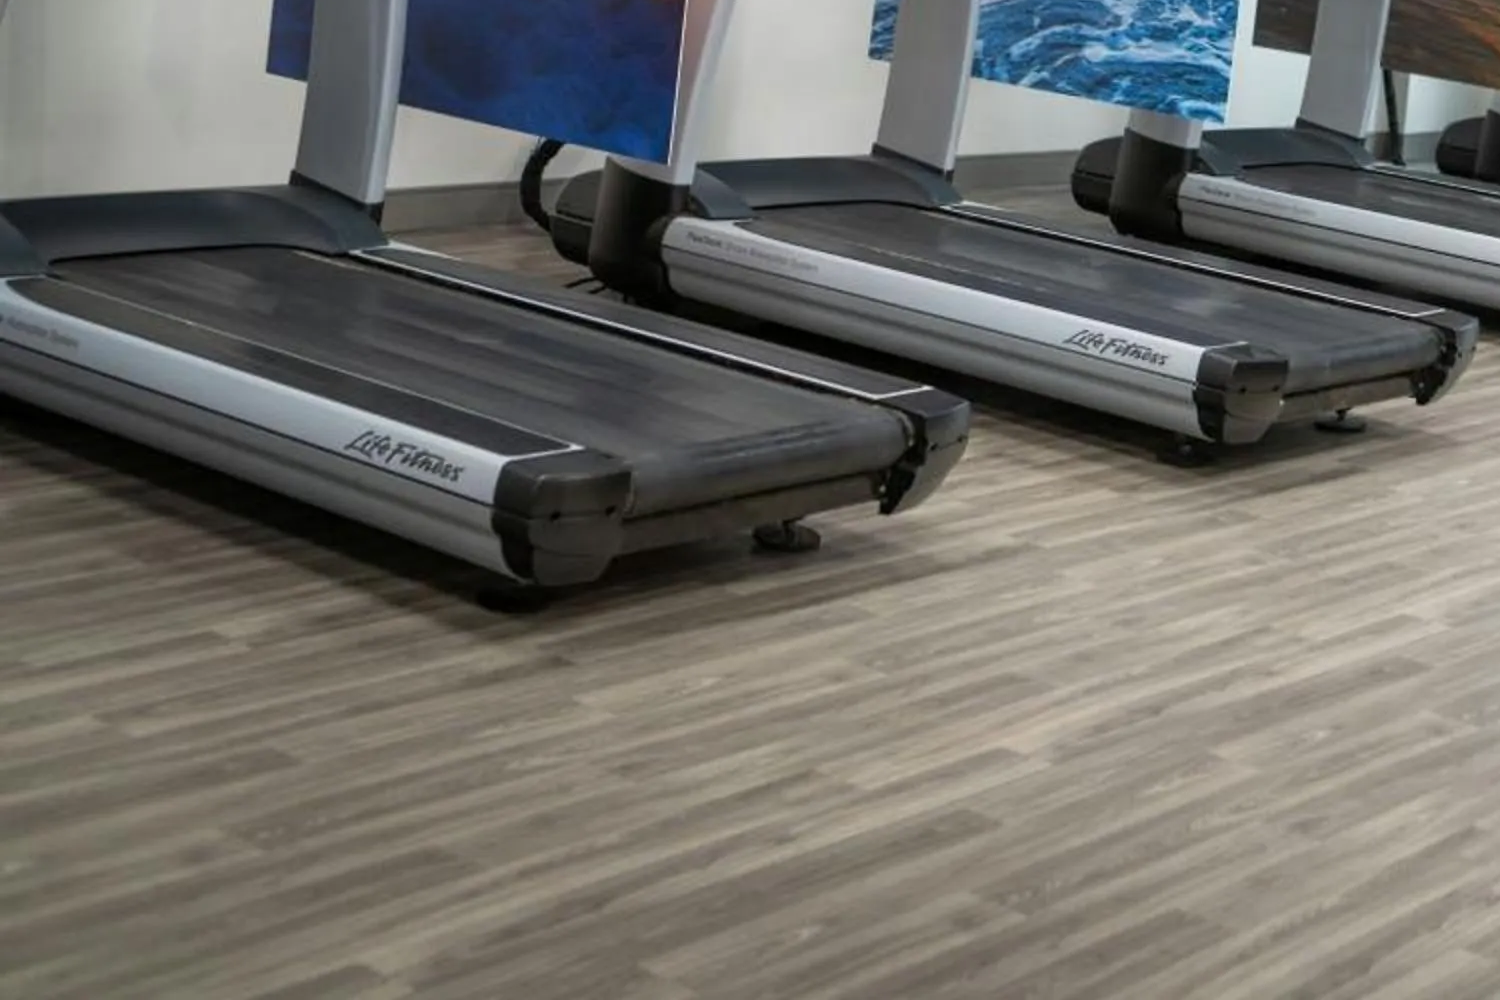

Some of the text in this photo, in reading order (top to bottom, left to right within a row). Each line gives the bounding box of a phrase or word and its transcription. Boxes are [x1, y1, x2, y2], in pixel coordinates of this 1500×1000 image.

[1061, 329, 1169, 365] Life Fitness
[343, 429, 466, 482] Life Fitness
